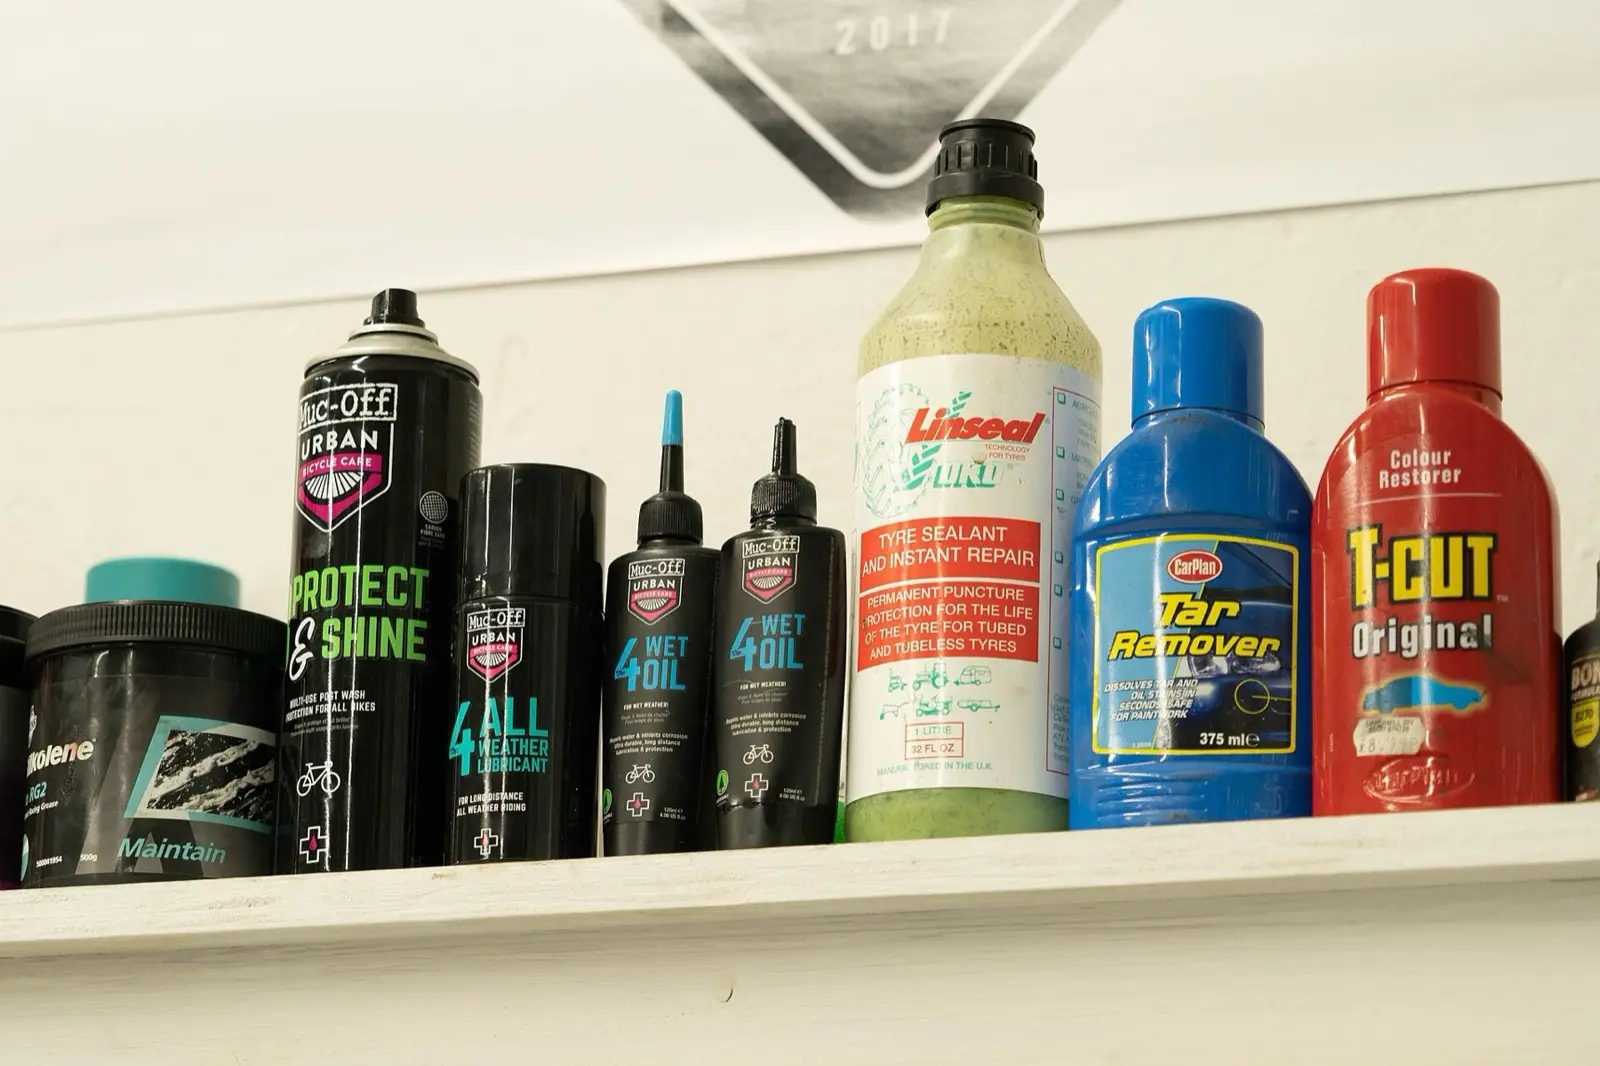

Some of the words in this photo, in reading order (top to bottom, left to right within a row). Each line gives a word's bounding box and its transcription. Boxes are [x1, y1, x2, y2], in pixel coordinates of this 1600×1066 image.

[836, 8, 955, 56] 2017
[299, 387, 392, 428] Muc-Off
[905, 407, 1046, 444] Linseal
[301, 429, 378, 460] URBAN
[985, 443, 1030, 453] TECHNOLOGY
[302, 457, 337, 477] BICYCLE
[340, 456, 372, 467] CARE
[988, 452, 1004, 460] FOR
[1005, 453, 1026, 461] TYRES
[1390, 448, 1451, 469] Colour
[1379, 467, 1461, 489] Restorer
[745, 537, 796, 555] Muc-Off
[879, 528, 917, 549] TYRE
[921, 525, 1008, 542] SEALANT
[630, 560, 682, 578] Muc-Off
[748, 557, 790, 569] URBAN
[862, 556, 886, 577] AND
[889, 546, 962, 568] INSTANT
[967, 547, 1034, 567] REPAIR
[1174, 558, 1216, 577] CarPlan
[1348, 524, 1497, 610] T-CUT
[291, 564, 430, 618] PROTECT
[633, 580, 676, 592] URBAN
[867, 587, 942, 609] PERMANENT
[943, 586, 1025, 601] PUNCTURE
[469, 610, 523, 630] Muc-Off
[862, 604, 932, 629] PROTECTION
[936, 603, 967, 616] FOR
[971, 603, 1000, 617] THE
[1004, 605, 1033, 620] LIFE
[1158, 591, 1241, 628] Tar
[321, 616, 428, 662] SHINE
[472, 631, 516, 646] URBAN
[729, 616, 757, 672] 4
[762, 613, 806, 636] WET
[865, 631, 877, 645] OF
[879, 626, 901, 639] THE
[904, 621, 939, 636] TYRE
[942, 620, 973, 634] FOR
[977, 621, 1027, 637] TUBED
[1353, 613, 1492, 659] Original
[759, 637, 804, 670] OIL
[870, 645, 892, 660] AND
[893, 638, 965, 653] TUBELESS
[969, 638, 1017, 653] TYRES
[1107, 630, 1281, 663] Remover
[614, 637, 641, 692] 4
[645, 636, 689, 656] WET
[642, 659, 686, 691] OIL
[341, 690, 366, 700] WASH
[1104, 679, 1153, 693] DISSOLVES
[1176, 678, 1199, 688] AND
[1130, 690, 1146, 700] OIL
[332, 702, 348, 712] ALL
[449, 700, 475, 776] 4
[479, 696, 549, 738] ALL
[1200, 732, 1225, 746] 375
[478, 738, 549, 757] WEATHER
[912, 745, 922, 754] 32
[924, 744, 936, 753] FL
[940, 744, 955, 753] OZ
[477, 757, 548, 774] LUBRICANT
[876, 762, 940, 777] MANUFATURED
[944, 762, 954, 770] IN
[956, 762, 974, 770] THE
[976, 762, 994, 770] U.K.
[458, 795, 468, 806] FOR
[470, 794, 486, 804] LONG
[488, 792, 524, 801] DISTANCE
[456, 806, 466, 818] ALL
[468, 804, 498, 815] WEATHER
[501, 803, 526, 812] RIDING
[117, 837, 227, 865] Maintain
